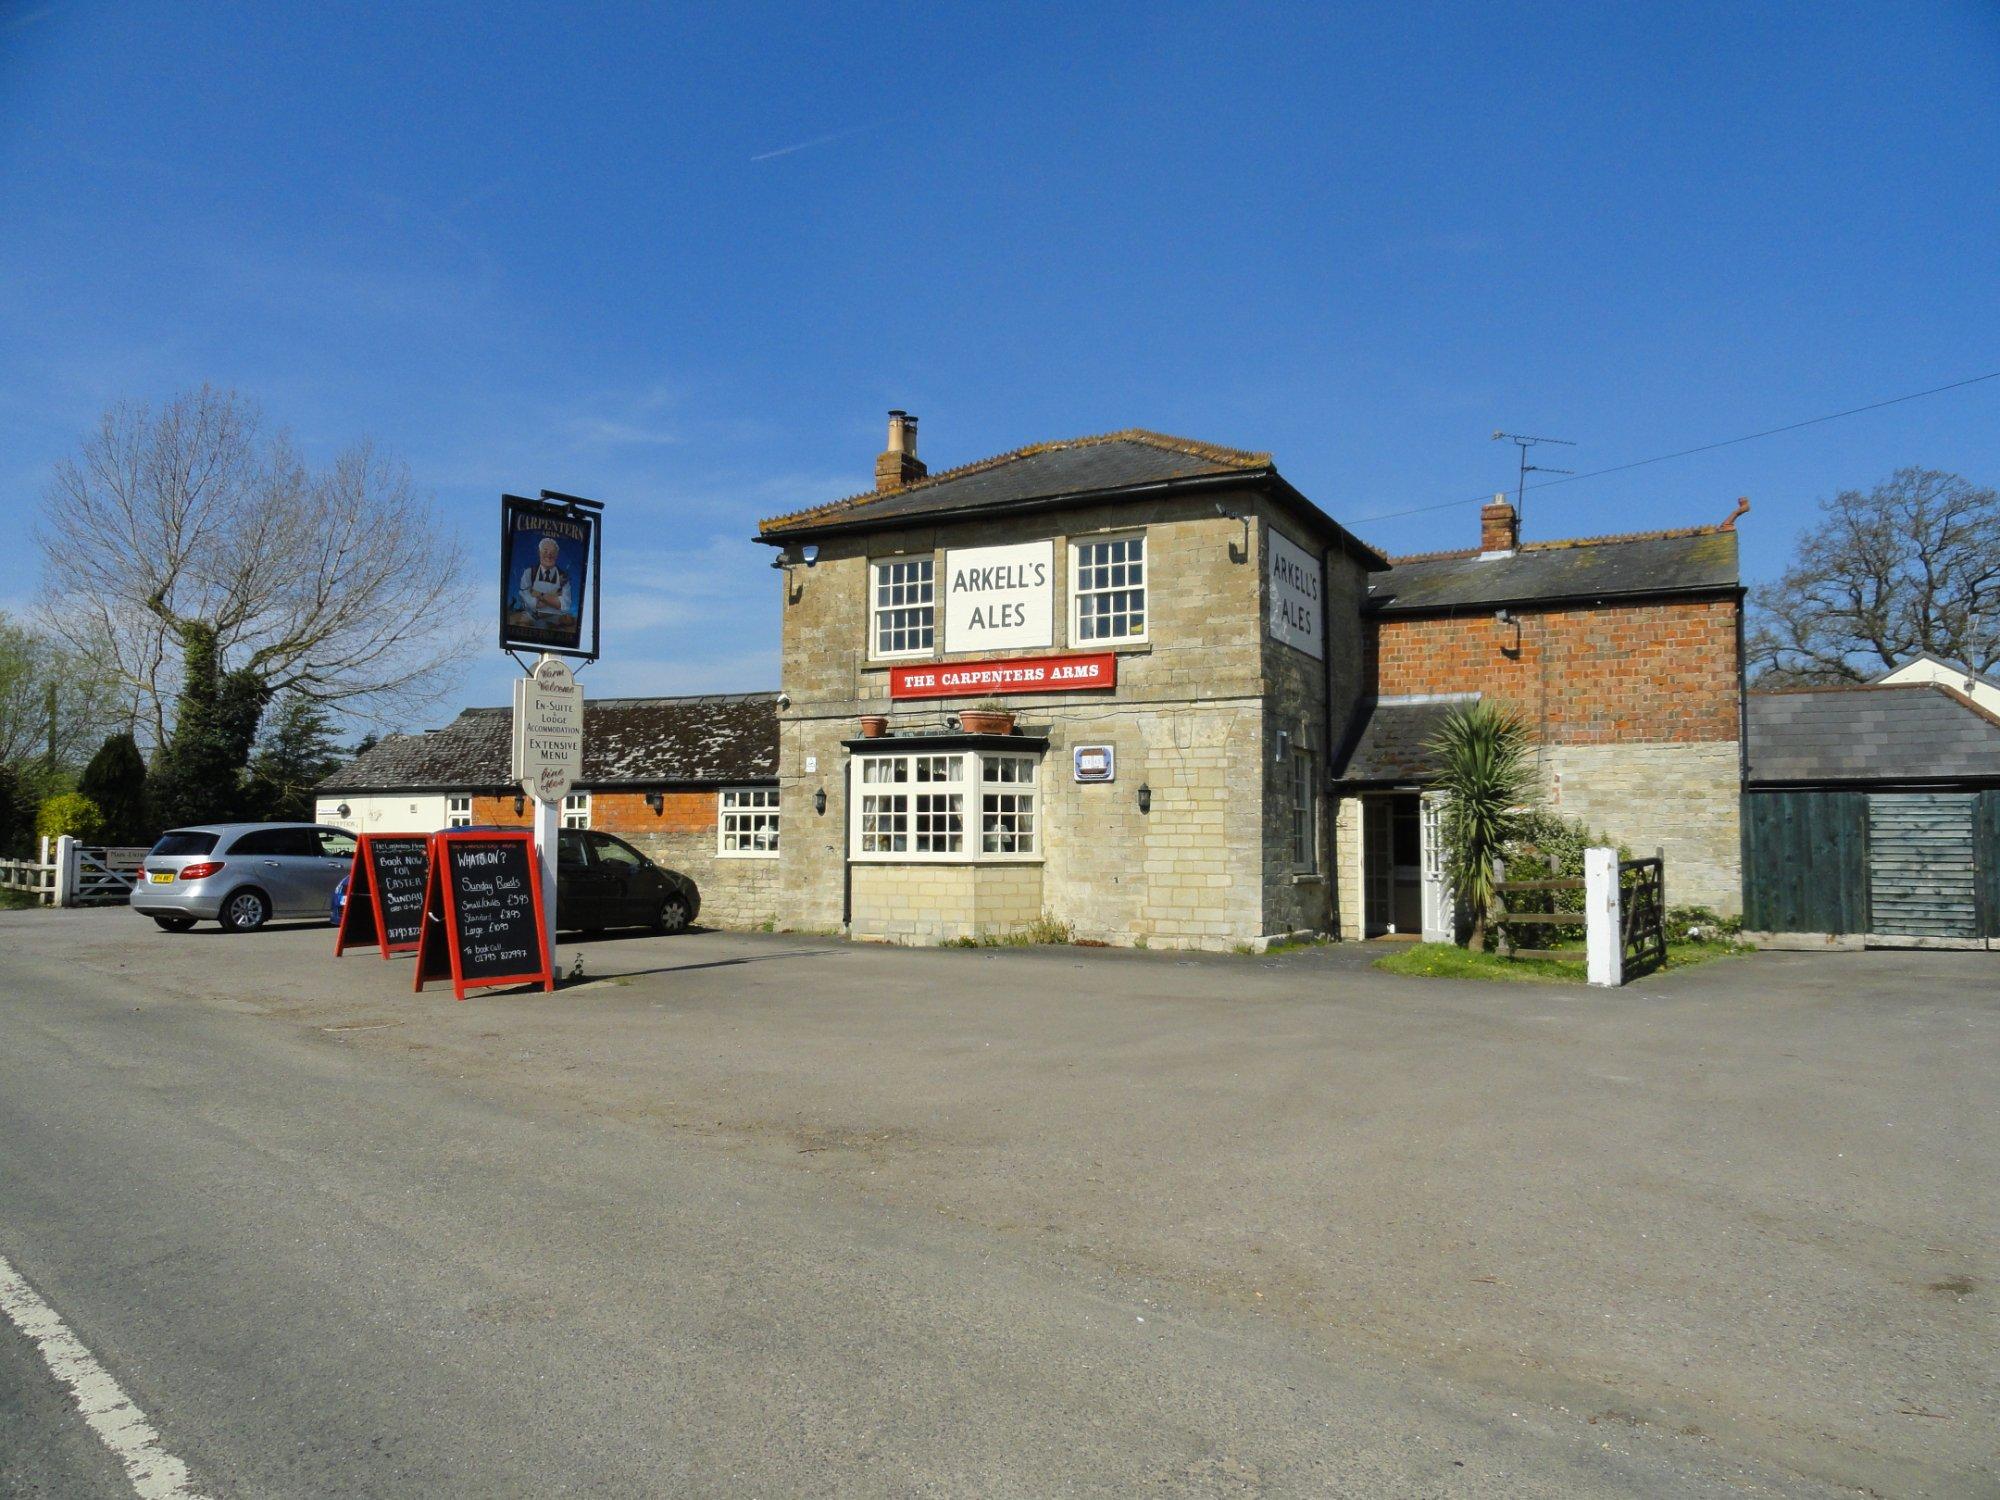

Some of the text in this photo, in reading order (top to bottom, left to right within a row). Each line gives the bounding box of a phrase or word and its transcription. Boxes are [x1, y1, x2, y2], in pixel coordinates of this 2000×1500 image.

[516, 513, 584, 541] CARPENTERS
[952, 562, 1046, 593] ARKELL'S
[1273, 553, 1318, 601] ARKELL'S
[968, 602, 1026, 631] ALES
[1281, 598, 1312, 635] ALES
[904, 664, 1099, 688] THE CARPENTERS ARMS
[529, 738, 578, 751] EXTENSIVE
[541, 750, 568, 760] MENU
[462, 875, 521, 895] Sunday Roasts
[474, 952, 497, 963] 01793
